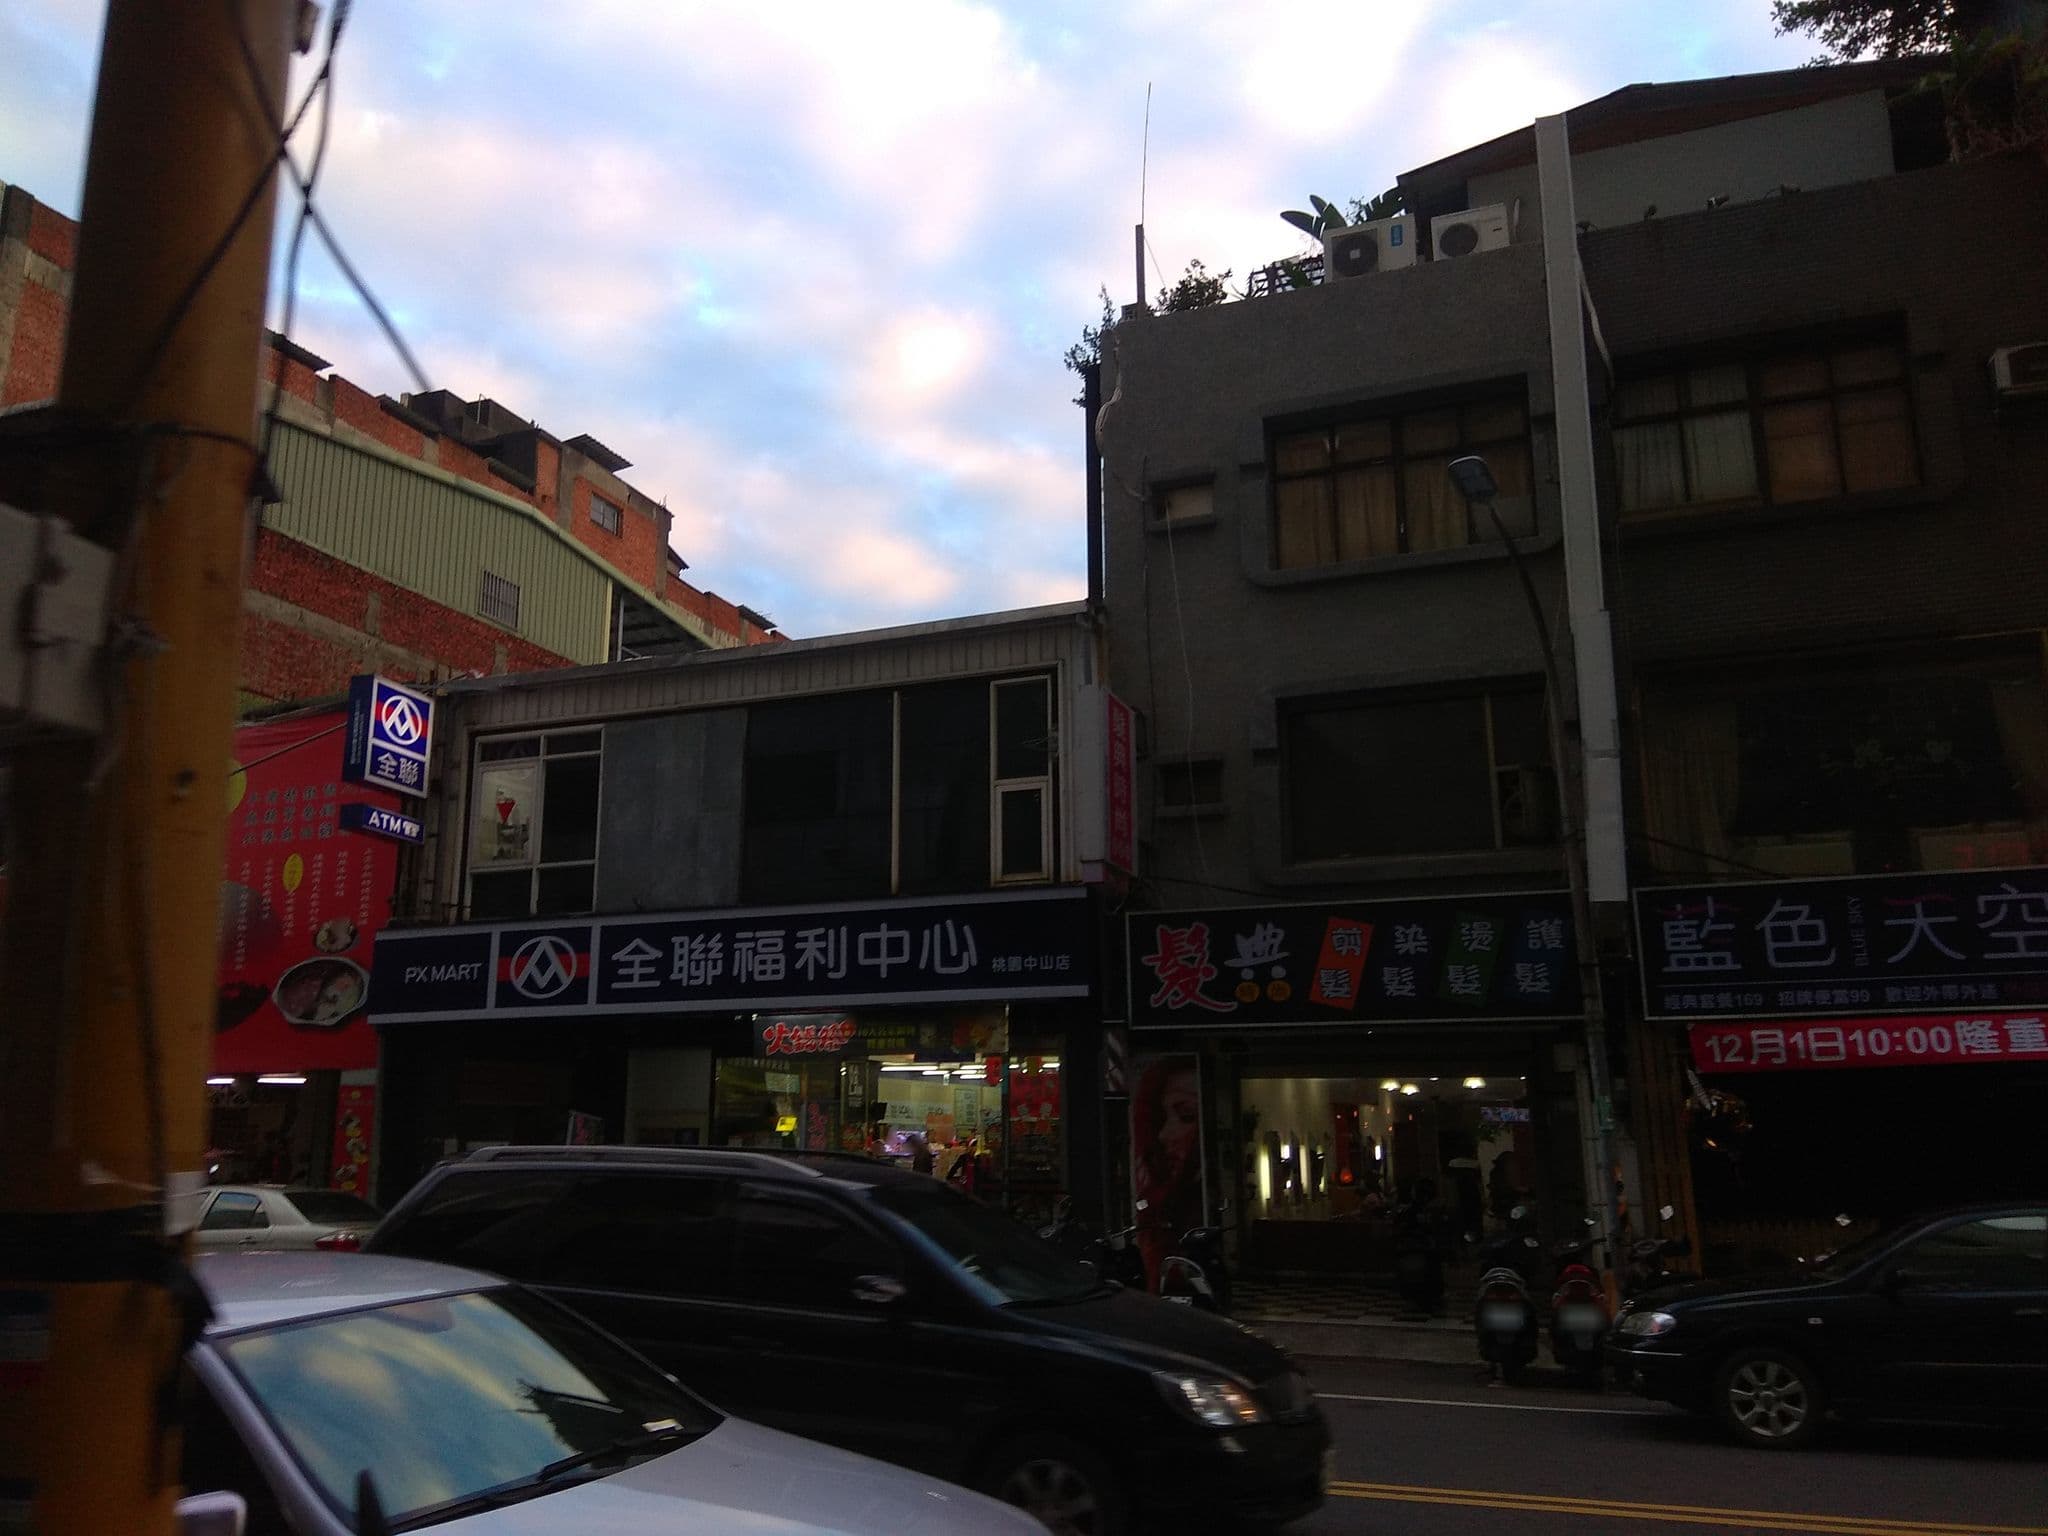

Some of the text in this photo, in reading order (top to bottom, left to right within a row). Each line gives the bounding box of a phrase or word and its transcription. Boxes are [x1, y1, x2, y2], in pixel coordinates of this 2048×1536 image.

[376, 751, 419, 786] 全聯
[368, 810, 402, 834] ATM
[611, 919, 979, 991] 全聯福利中心
[404, 962, 482, 985] PX MART
